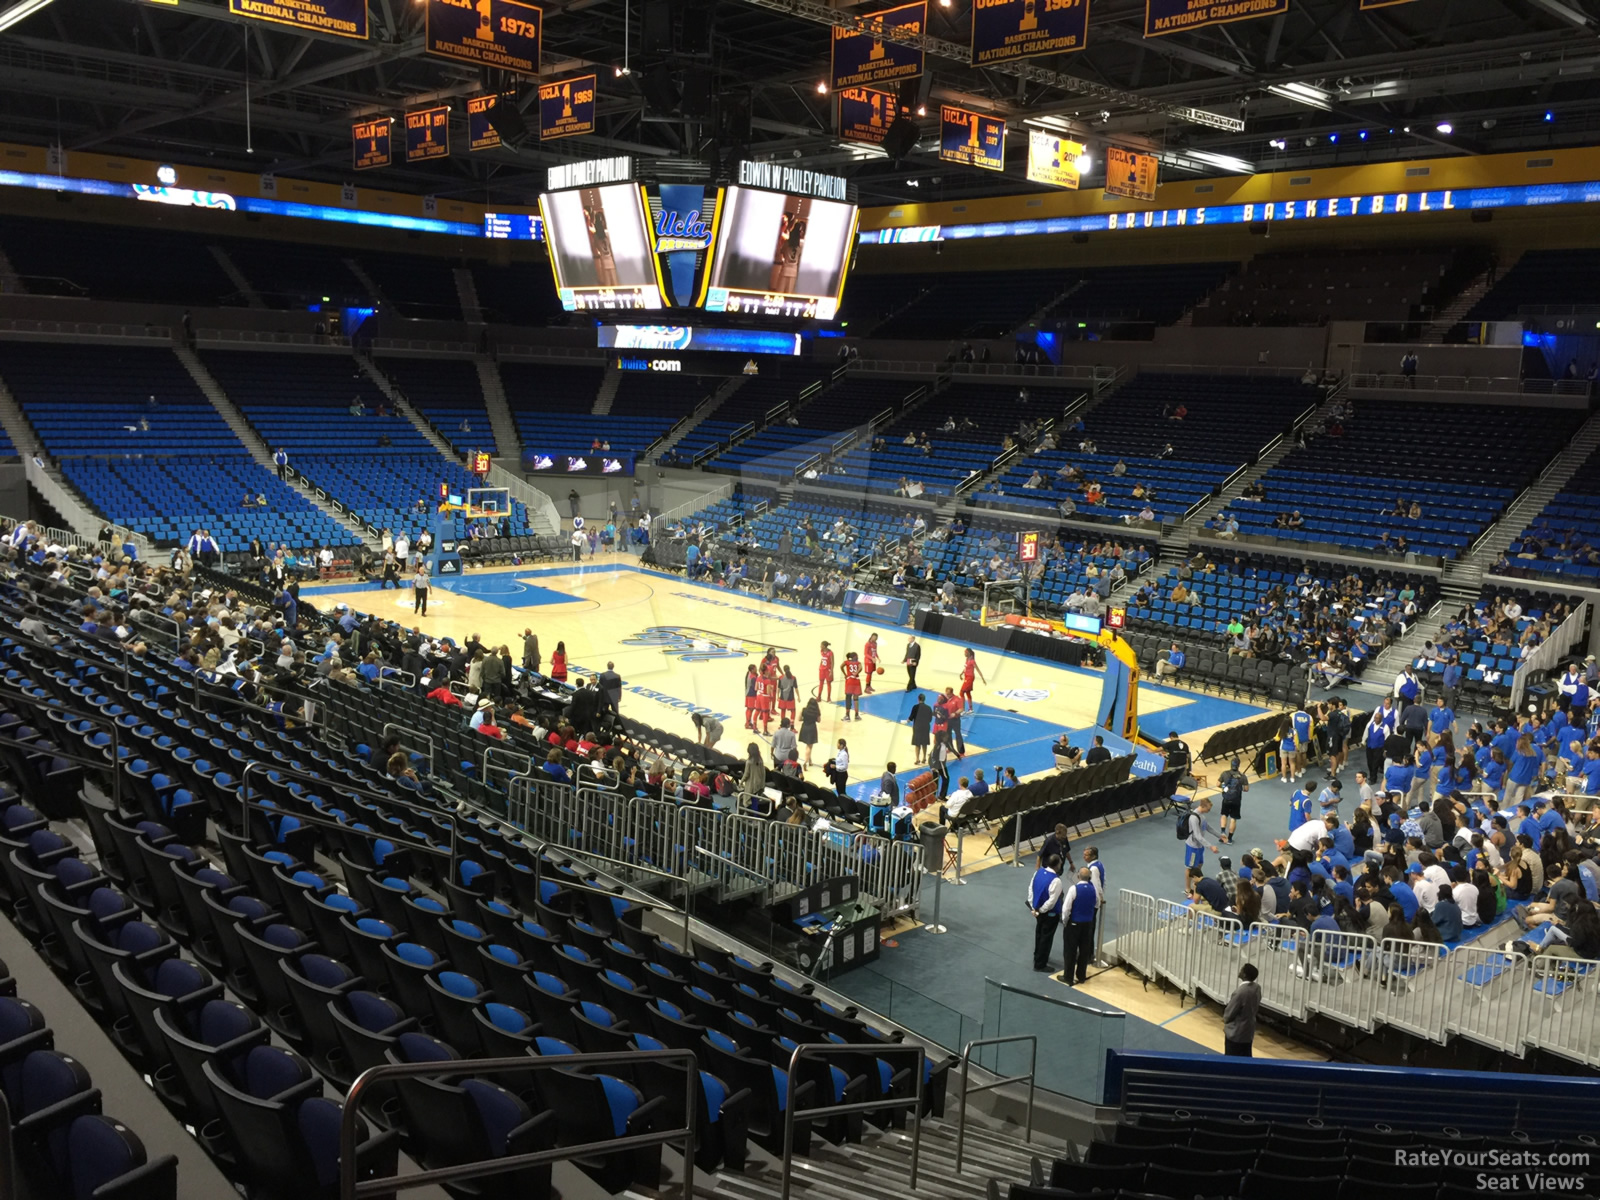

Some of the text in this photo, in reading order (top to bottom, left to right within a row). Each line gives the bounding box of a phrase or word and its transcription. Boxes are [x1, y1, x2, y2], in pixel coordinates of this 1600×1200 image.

[241, 1, 357, 33] NATIONAL CHAMPIONS
[1154, 0, 1277, 30] NATIONAL CHAMPIONS
[500, 16, 535, 39] 1973
[1004, 29, 1050, 45] BASKETBALL
[462, 37, 507, 54] BASKETBALL
[978, 35, 1077, 61] NATIONAL CHAMPIONS
[435, 40, 532, 70] NATIONAL CHAMPIONS
[858, 58, 894, 72] BASKETBALL
[837, 63, 917, 86] NATIONAL CHAMPIONS
[541, 86, 560, 100] UCLA
[574, 89, 593, 104] 1969
[842, 88, 868, 103] UCLA
[469, 100, 487, 113] UCLA
[407, 115, 425, 129] UCLA
[943, 109, 968, 126] UCLA
[355, 126, 371, 140] UCLA
[943, 149, 969, 161] NATIONAL
[1109, 149, 1129, 164] UCLA
[596, 156, 630, 183] PAVILION
[741, 160, 847, 201] EDWIN W PAULEY PAVILION
[1109, 191, 1455, 230] BRUINS BASKETBALL
[656, 209, 712, 240] Ucla
[476, 460, 487, 471] 30
[1023, 543, 1035, 558] 30
[1111, 615, 1122, 625] 30
[849, 664, 857, 673] 33
[1132, 759, 1157, 773] ealth
